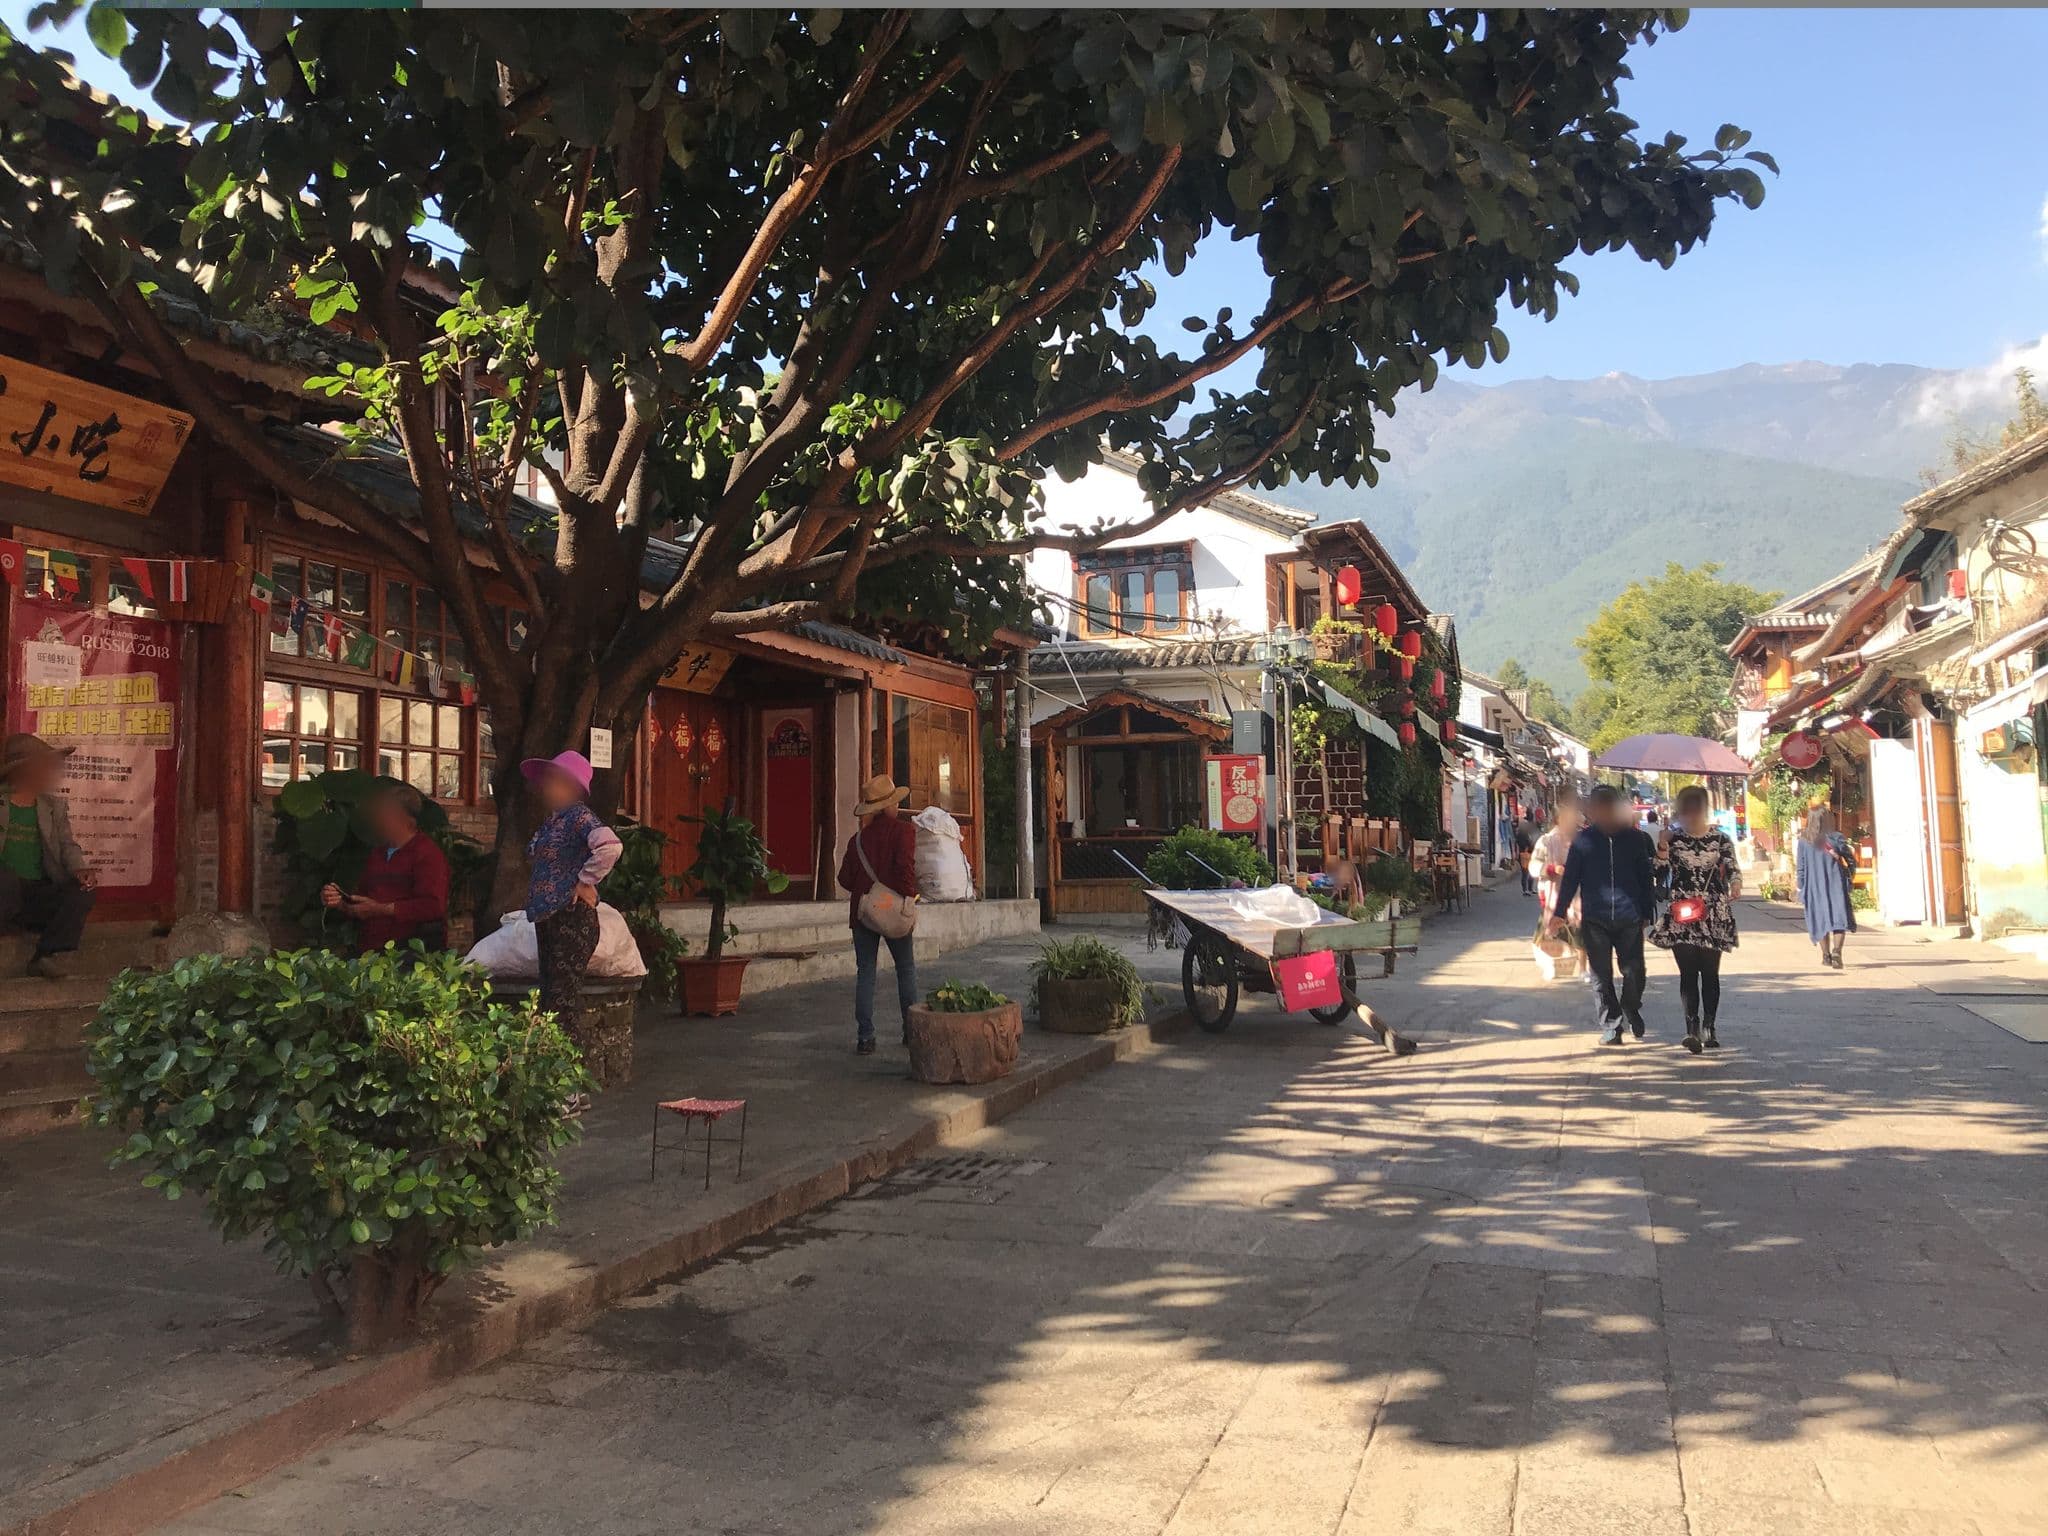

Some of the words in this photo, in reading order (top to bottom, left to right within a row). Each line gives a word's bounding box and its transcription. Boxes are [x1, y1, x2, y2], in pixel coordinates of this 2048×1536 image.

[0, 375, 122, 483] 小吃
[81, 634, 135, 654] RUSSIA
[137, 643, 170, 660] 2018
[116, 631, 138, 641] WORLD
[37, 652, 76, 666] 旺铺转让
[112, 676, 156, 704] 热血
[40, 710, 77, 736] 烧烤
[81, 709, 121, 735] 啤酒
[125, 707, 171, 735] 足球
[676, 724, 689, 747] 福
[707, 729, 721, 752] 福
